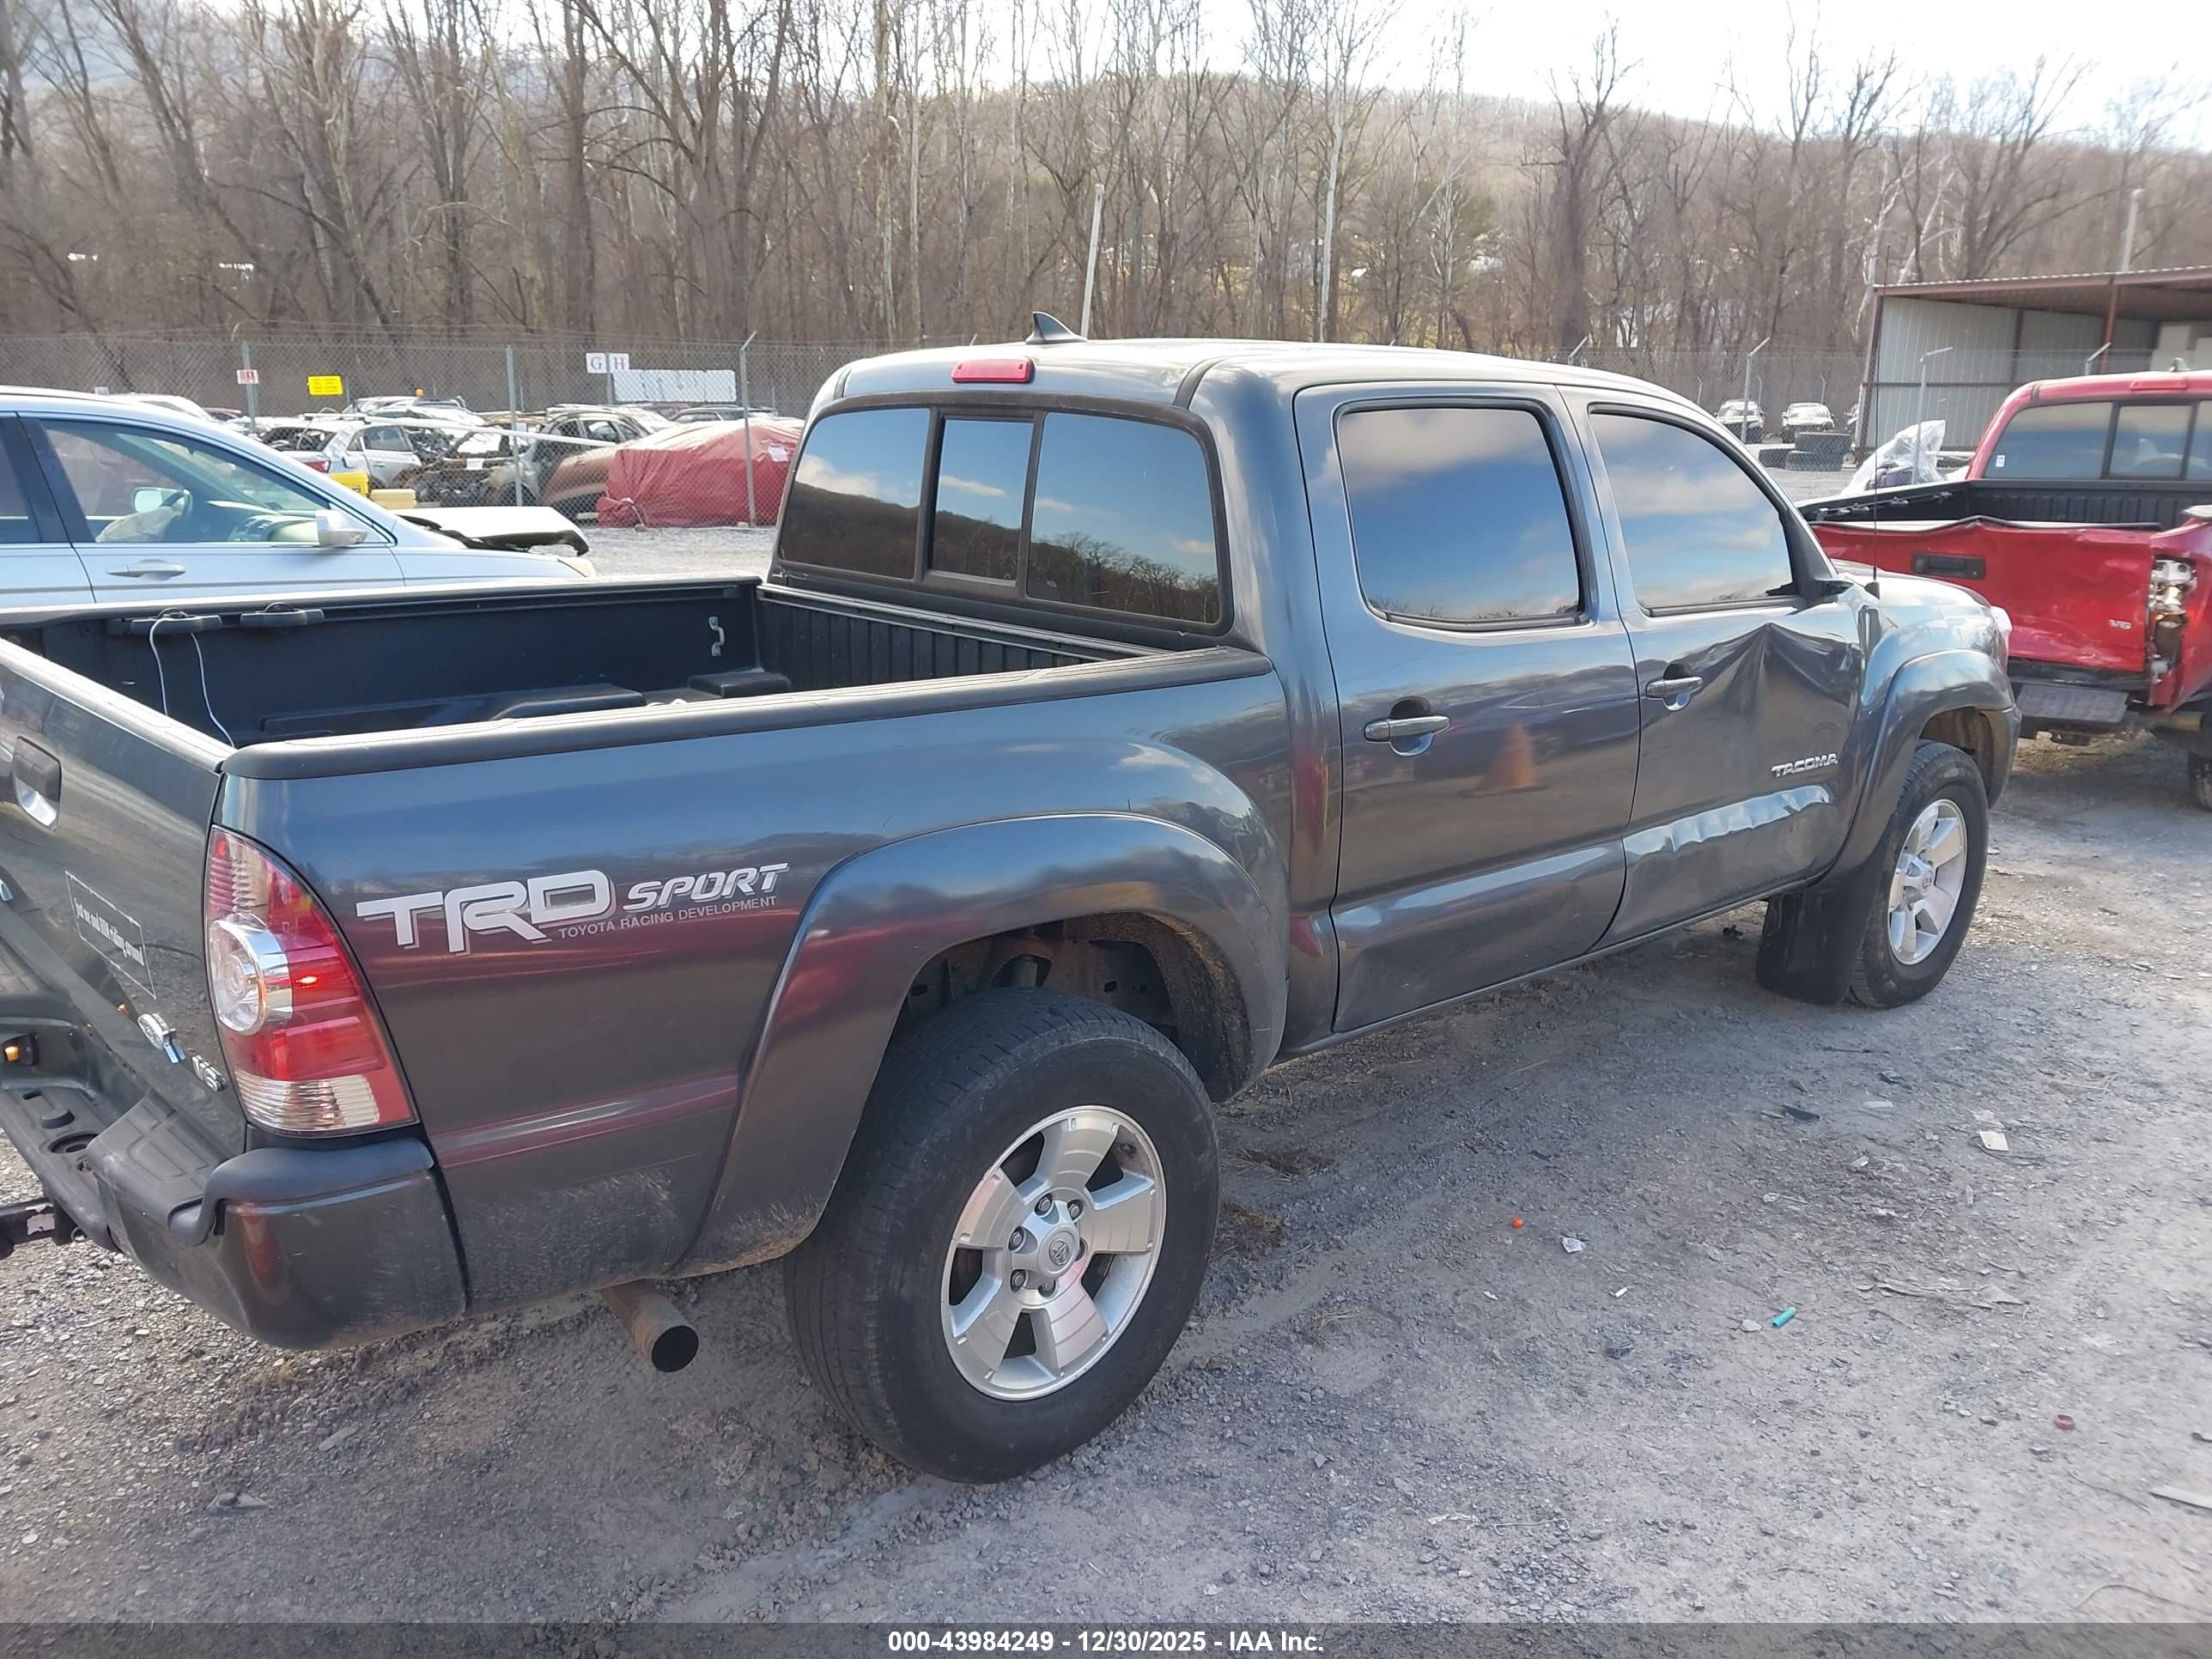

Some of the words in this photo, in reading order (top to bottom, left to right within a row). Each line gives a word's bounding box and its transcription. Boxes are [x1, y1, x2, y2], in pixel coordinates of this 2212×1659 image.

[590, 356, 602, 370] G
[613, 356, 624, 370] H
[1771, 752, 1838, 778] TACOMA
[355, 869, 617, 957] TRD
[623, 862, 789, 914] SPORT
[558, 920, 616, 940] TOYOTA
[619, 910, 674, 930] RACING
[678, 896, 777, 921] DEVELOPMENT
